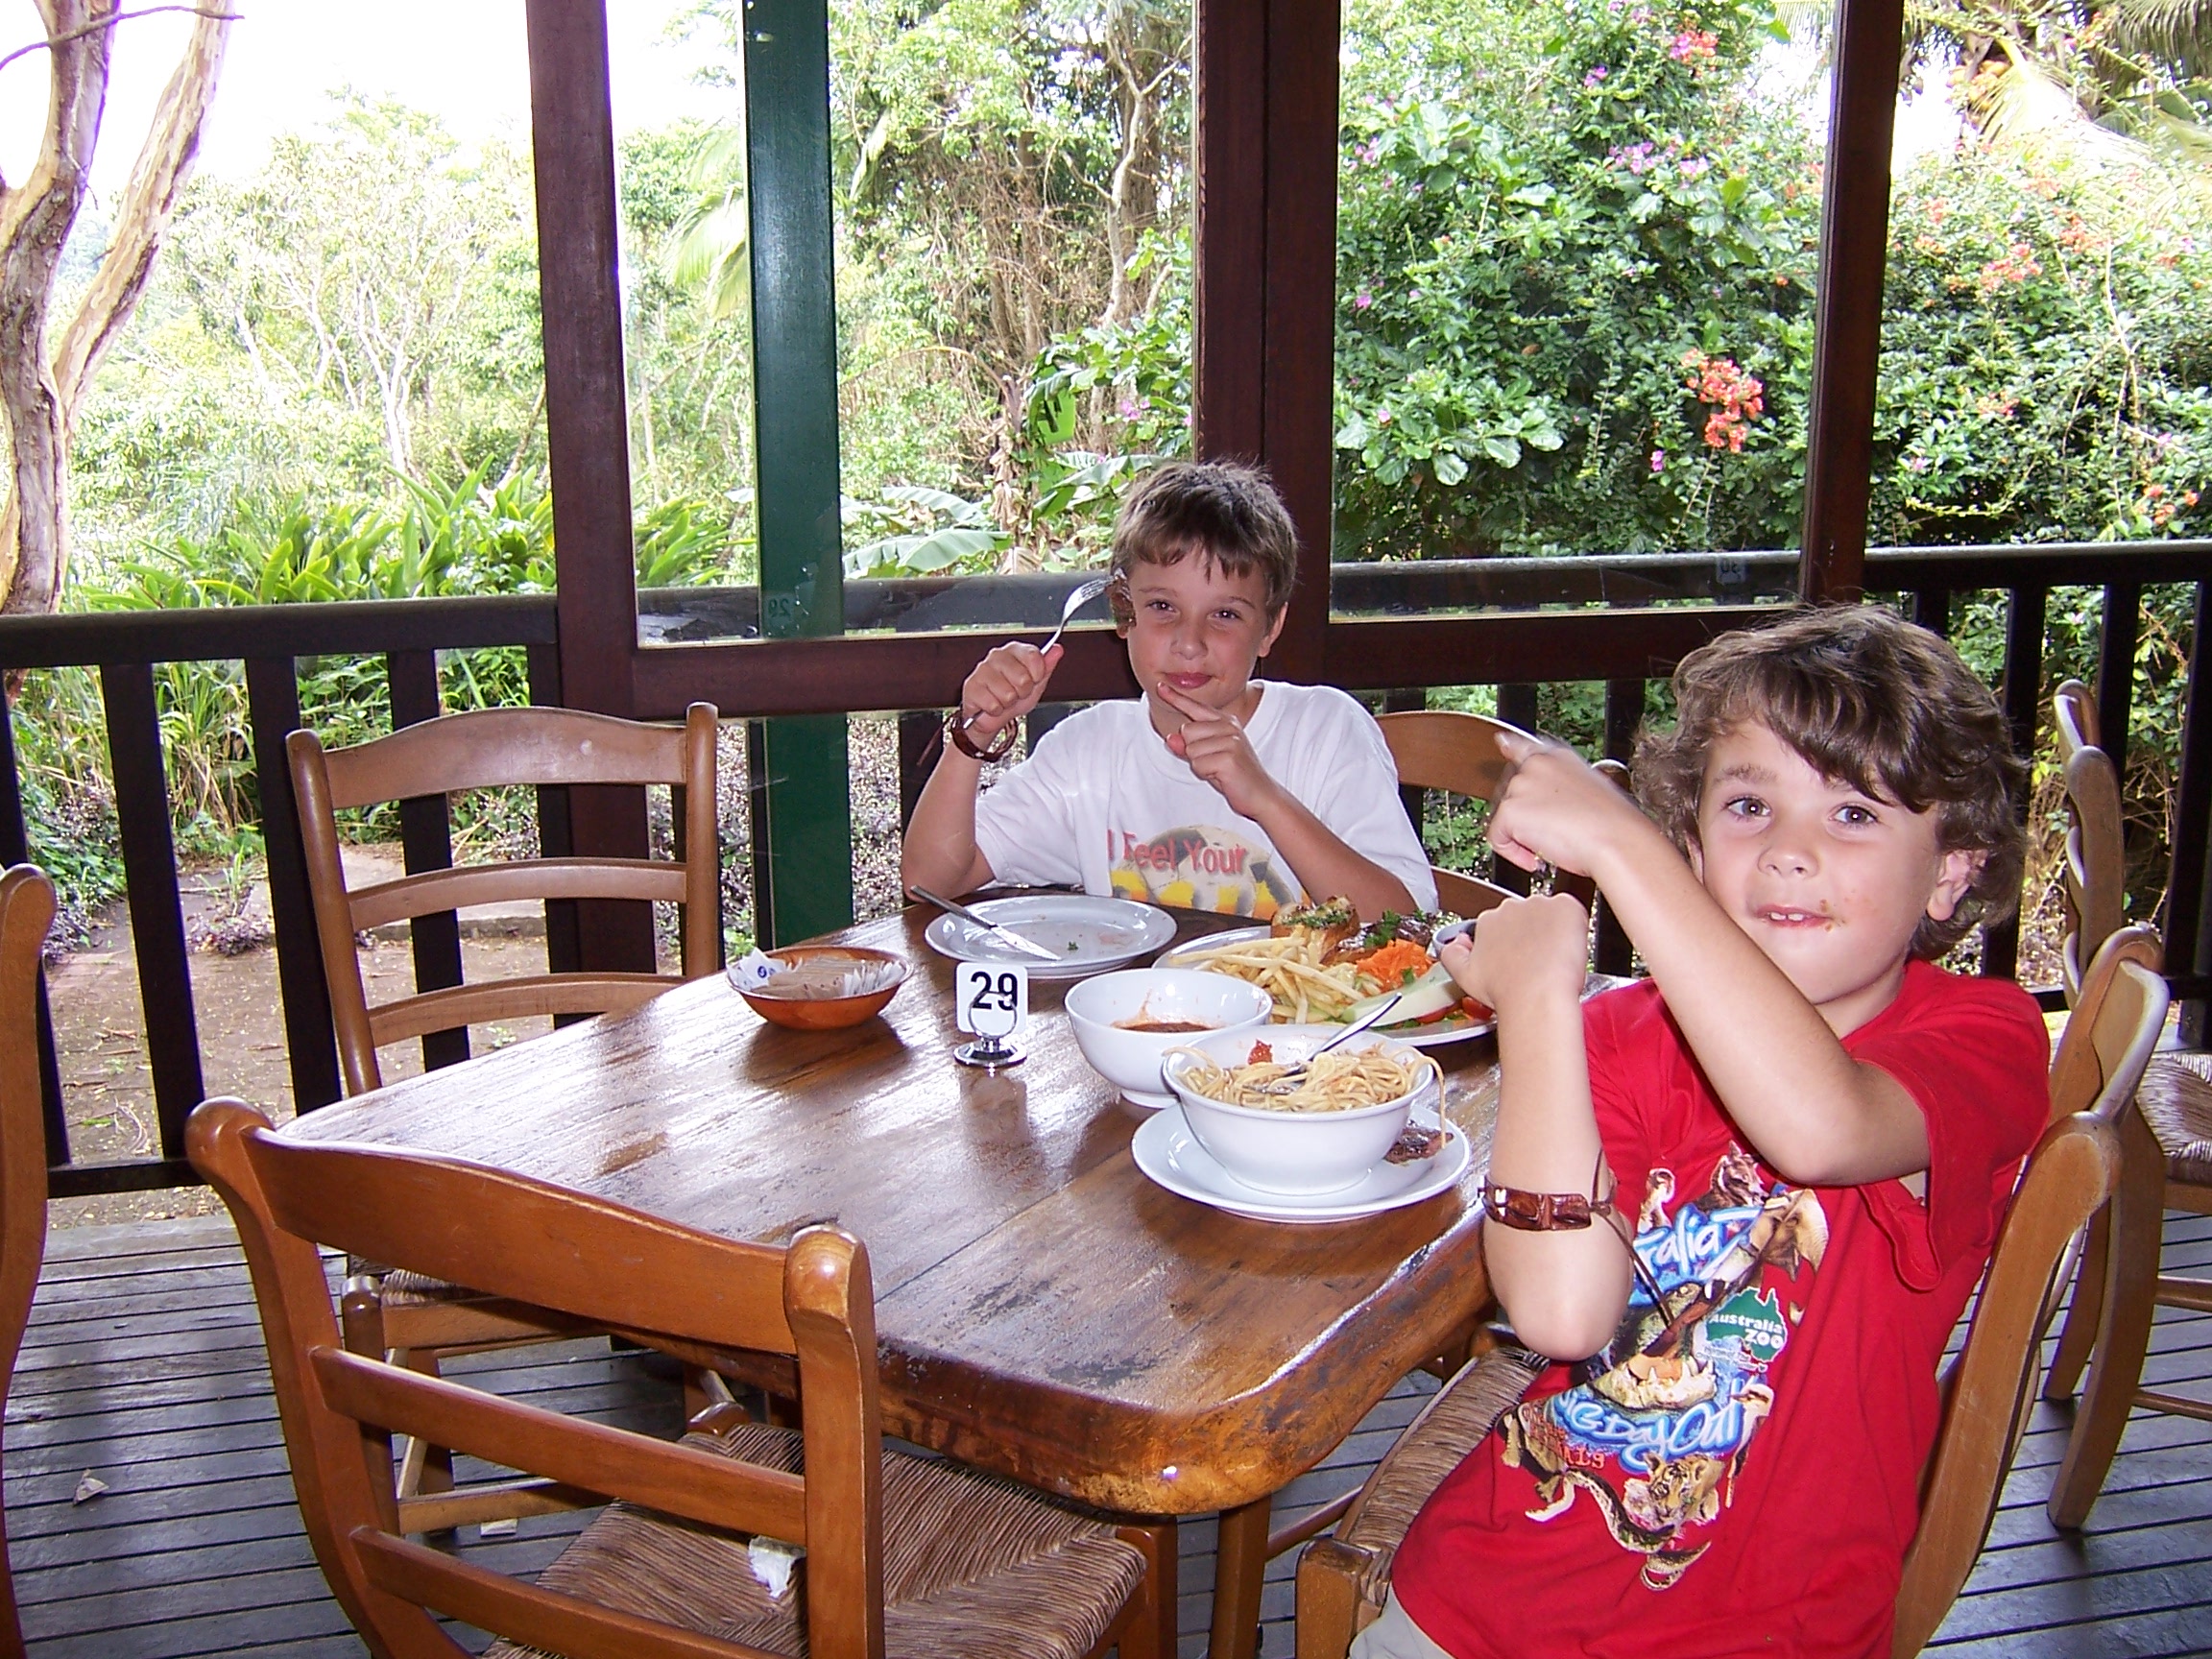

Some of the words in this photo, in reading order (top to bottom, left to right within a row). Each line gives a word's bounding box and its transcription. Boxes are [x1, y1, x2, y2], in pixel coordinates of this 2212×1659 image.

[1107, 830, 1114, 860] I
[1123, 830, 1176, 871] Feel
[1183, 837, 1247, 875] Your
[971, 971, 1018, 1011] 29
[1709, 1313, 1784, 1334] Australia
